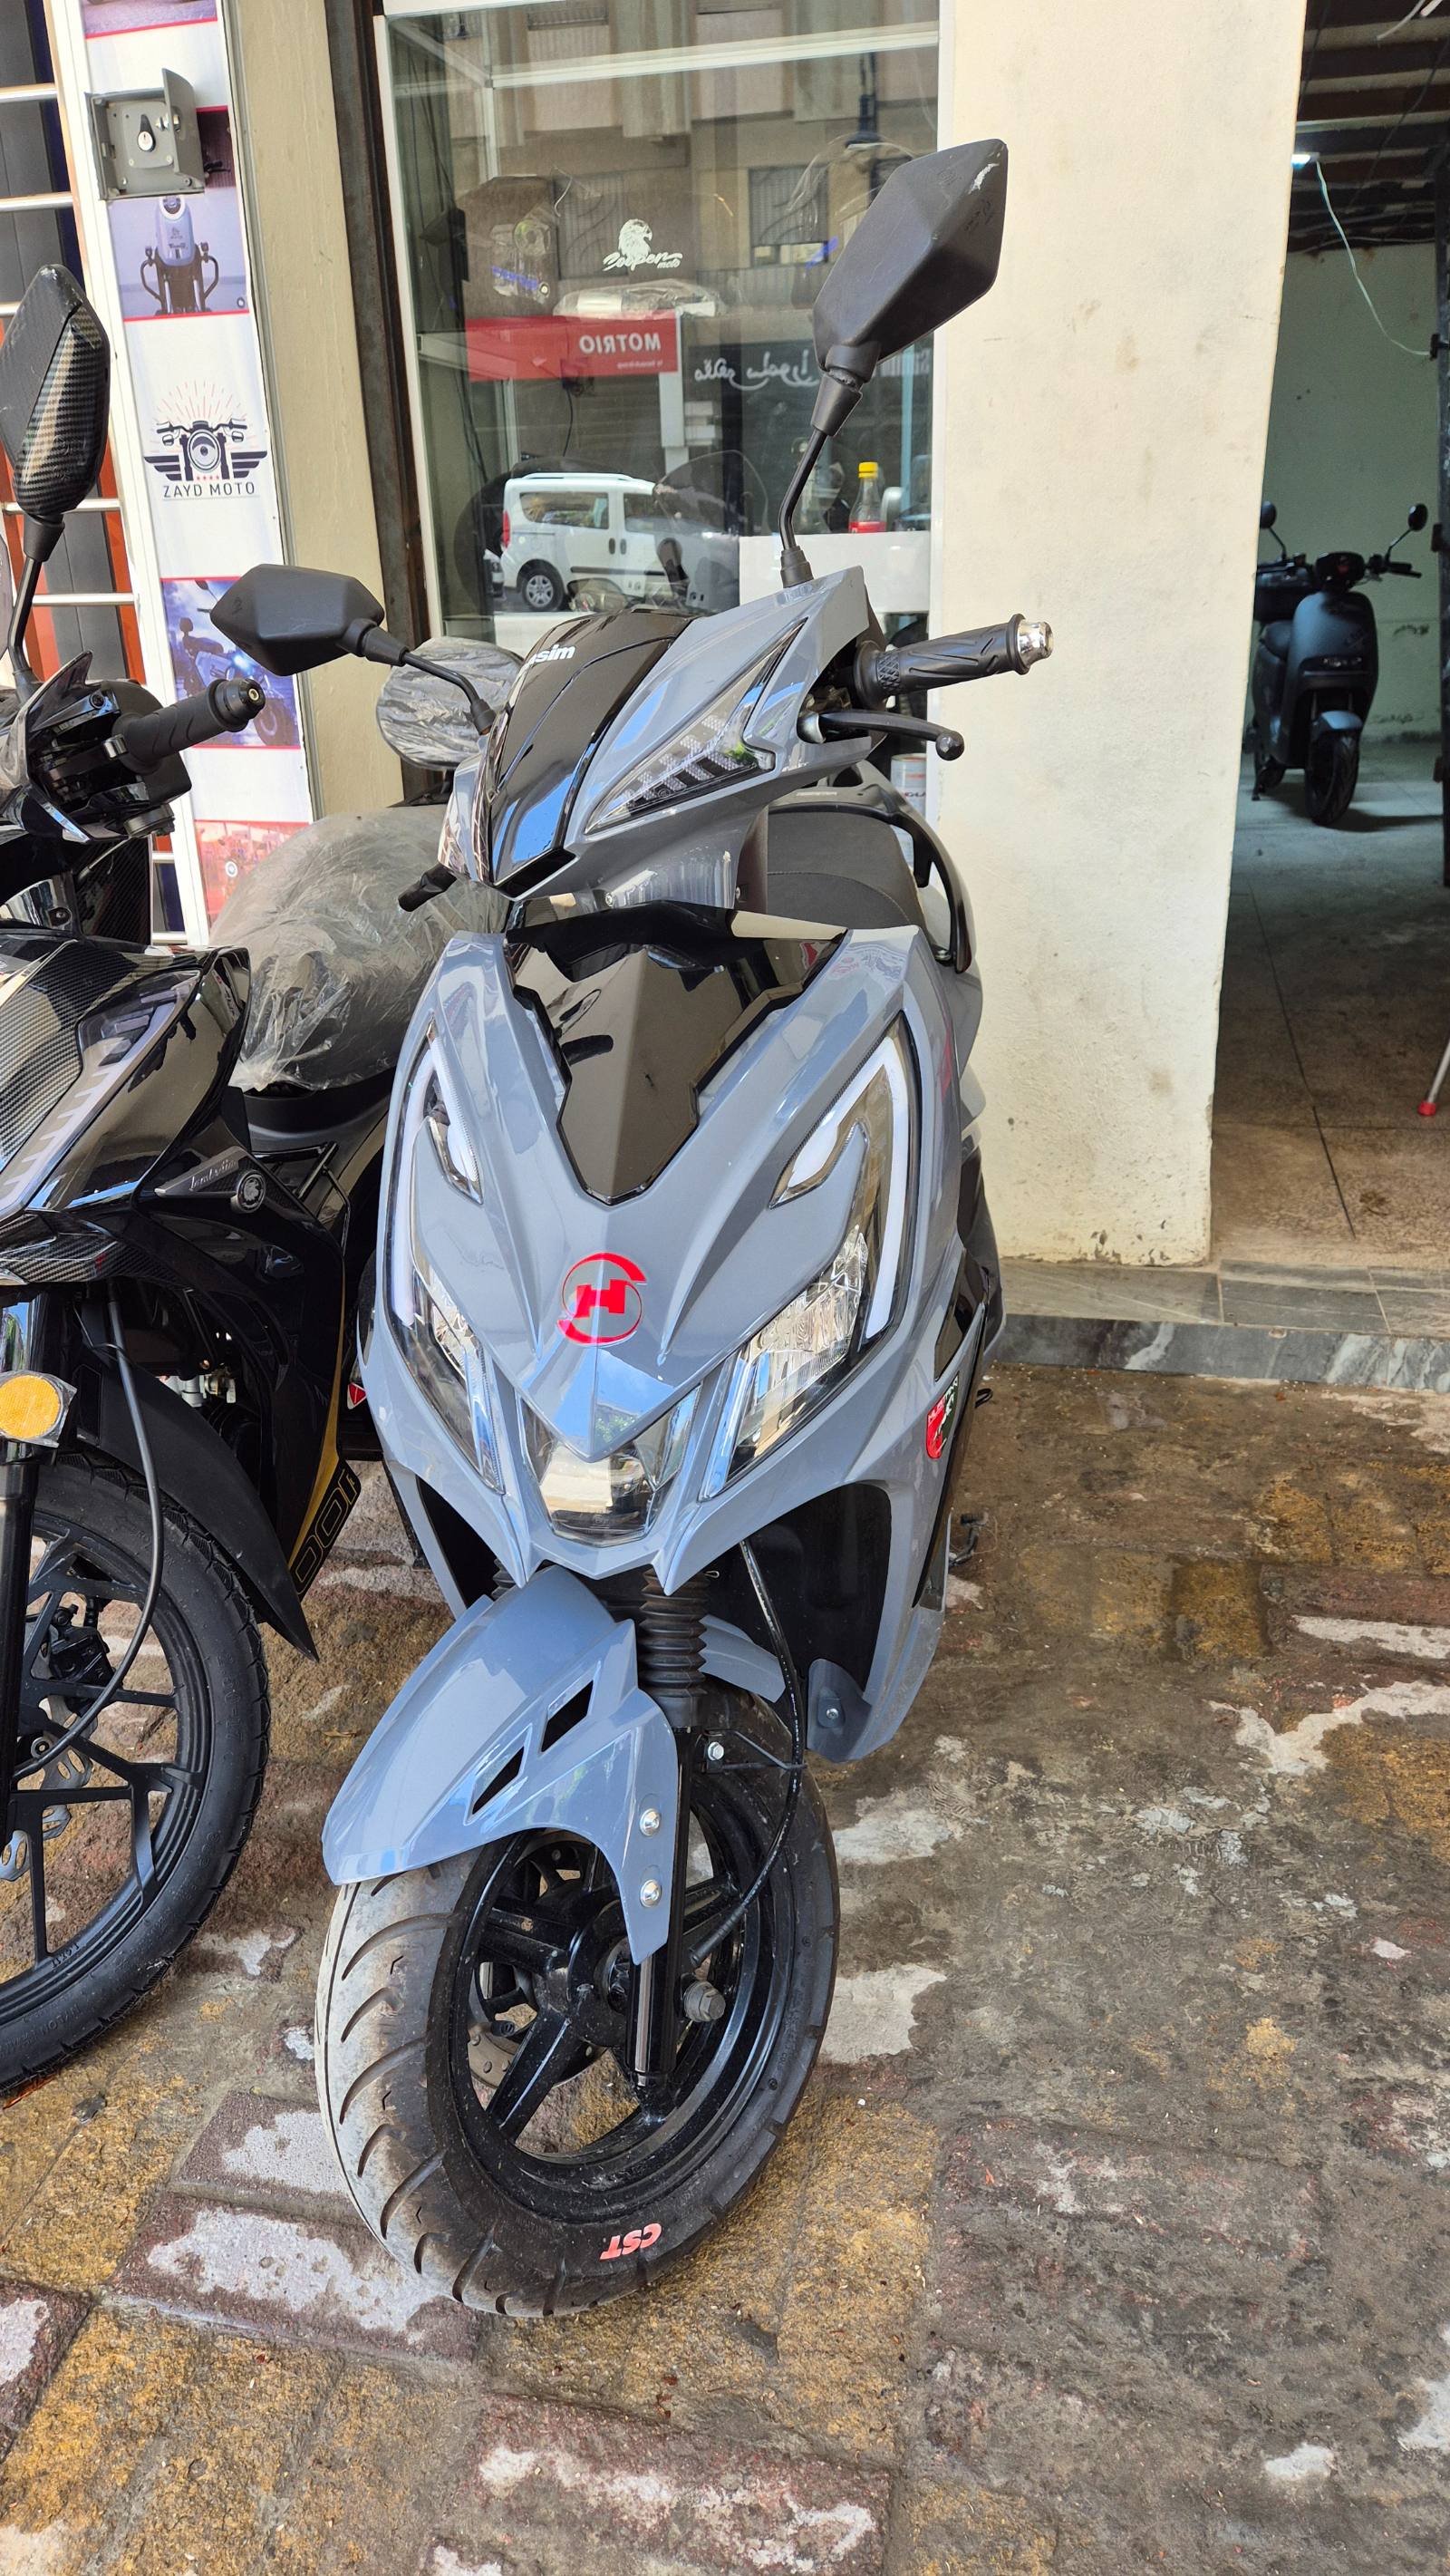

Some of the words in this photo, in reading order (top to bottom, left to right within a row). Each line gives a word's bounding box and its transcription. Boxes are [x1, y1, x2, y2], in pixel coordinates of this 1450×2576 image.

[163, 484, 202, 498] ZAYD
[209, 481, 255, 496] MOTO
[599, 2223, 662, 2261] CST
